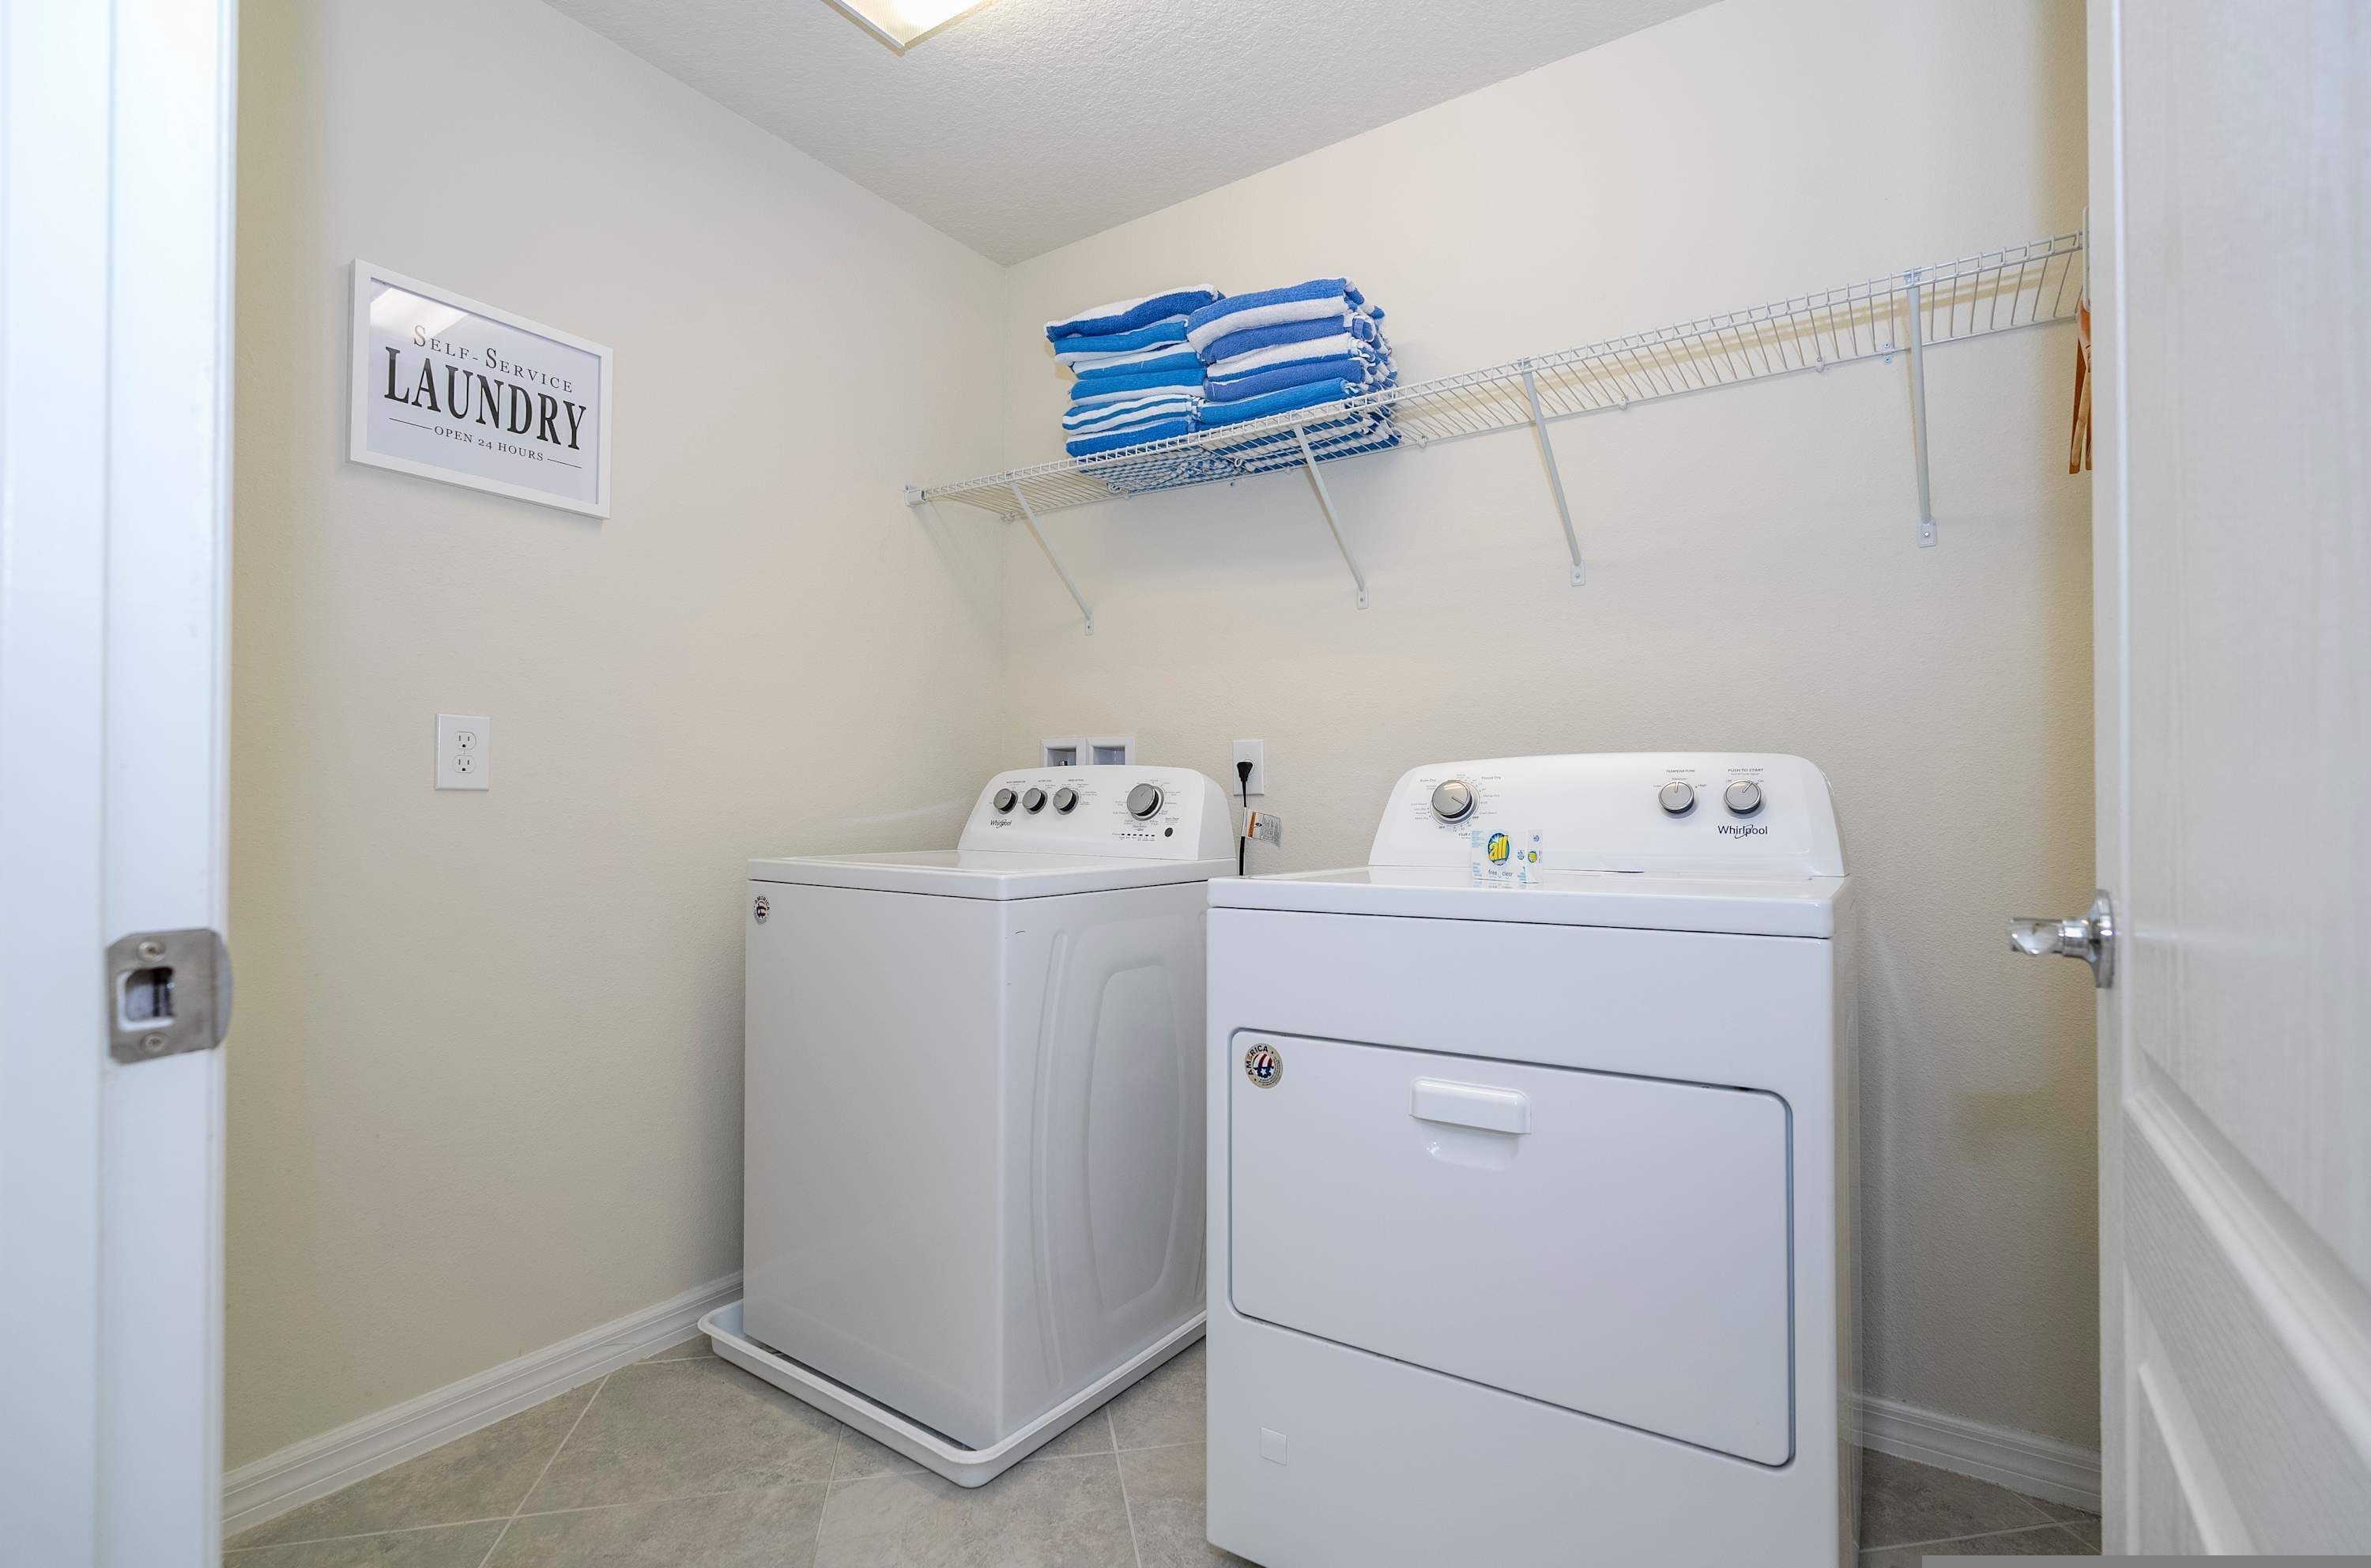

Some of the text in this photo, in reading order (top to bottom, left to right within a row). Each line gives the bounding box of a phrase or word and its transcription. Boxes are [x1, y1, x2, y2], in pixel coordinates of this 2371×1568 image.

[384, 346, 586, 450] LAUNDRY
[434, 425, 545, 462] OPEN 24 HOURS
[990, 819, 1012, 828] Whirlpool
[1717, 824, 1768, 839] Whirlpool
[1489, 835, 1509, 861] all
[1246, 1045, 1268, 1076] AMERICA
